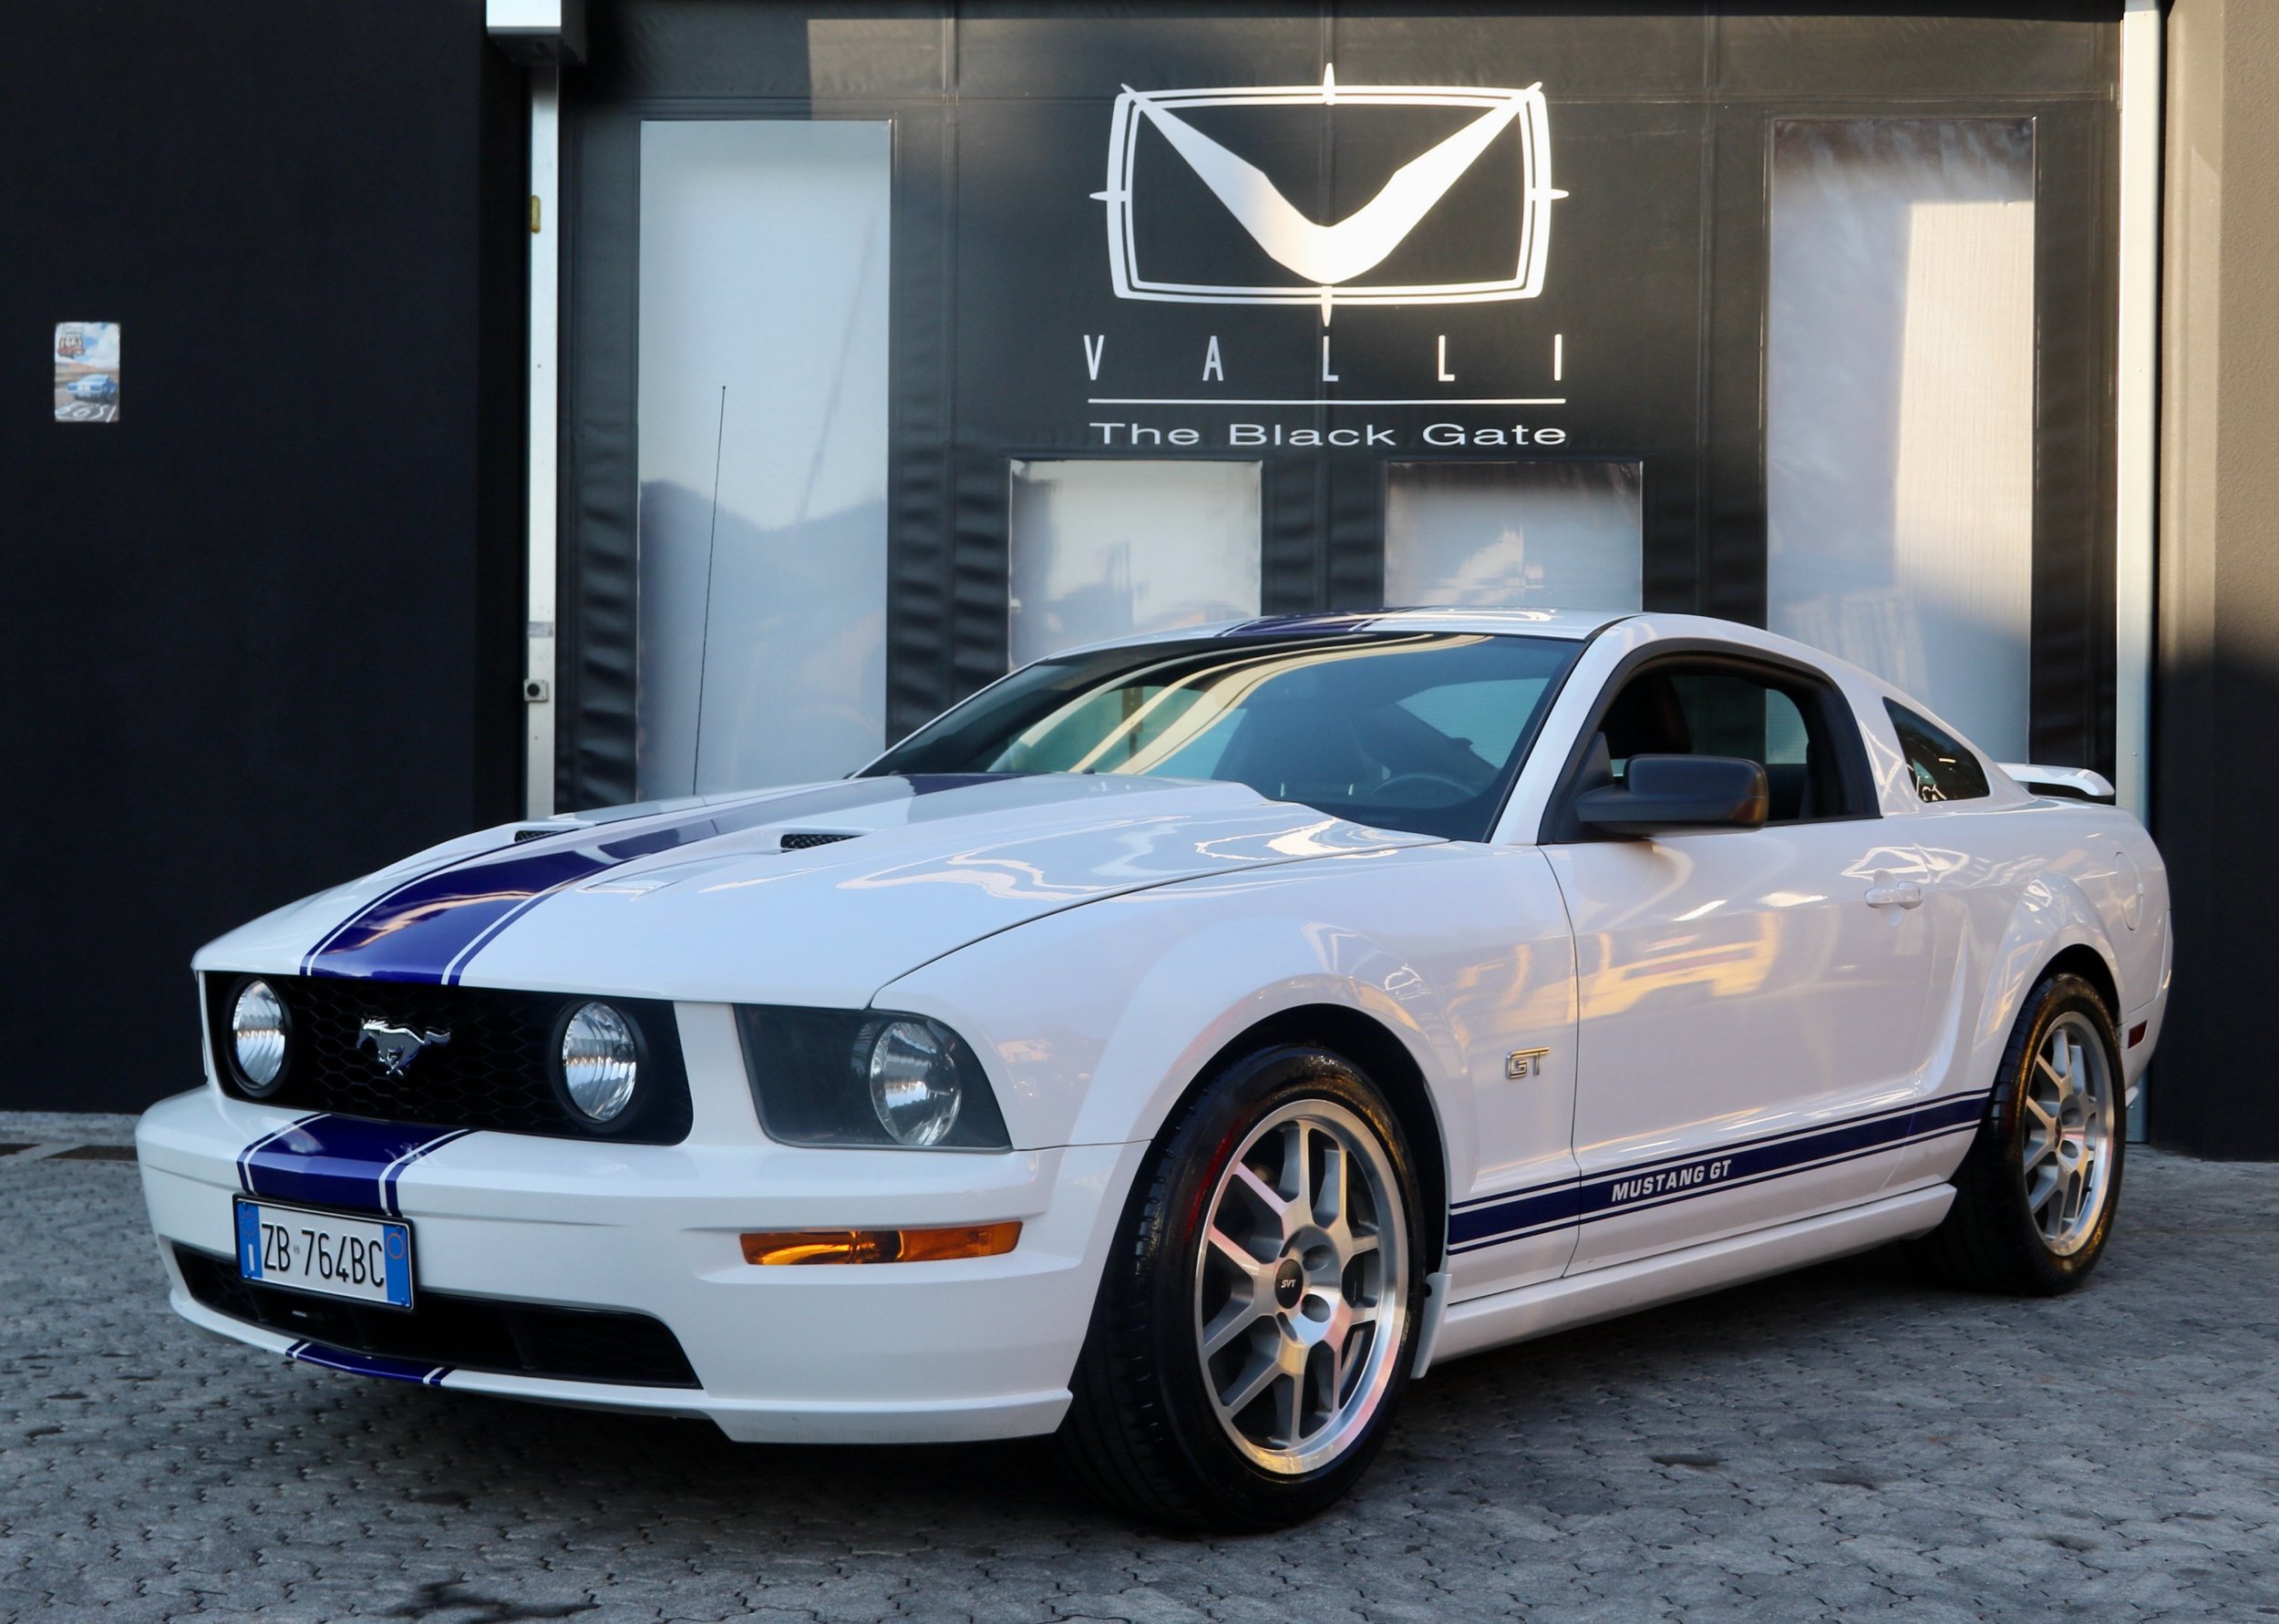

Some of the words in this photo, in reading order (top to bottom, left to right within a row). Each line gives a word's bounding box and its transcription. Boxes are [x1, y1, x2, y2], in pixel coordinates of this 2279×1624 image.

[1084, 334, 1562, 381] VALLI
[1089, 423, 1200, 445] The
[1229, 423, 1396, 445] Black
[1422, 423, 1567, 445] Gate
[1507, 1047, 1550, 1079] GT
[1612, 1167, 1704, 1201] MUSTANG
[1709, 1159, 1732, 1179] GT
[262, 1222, 291, 1271] ZB
[302, 1229, 385, 1287] 764BC
[1281, 1280, 1296, 1289] SVT
